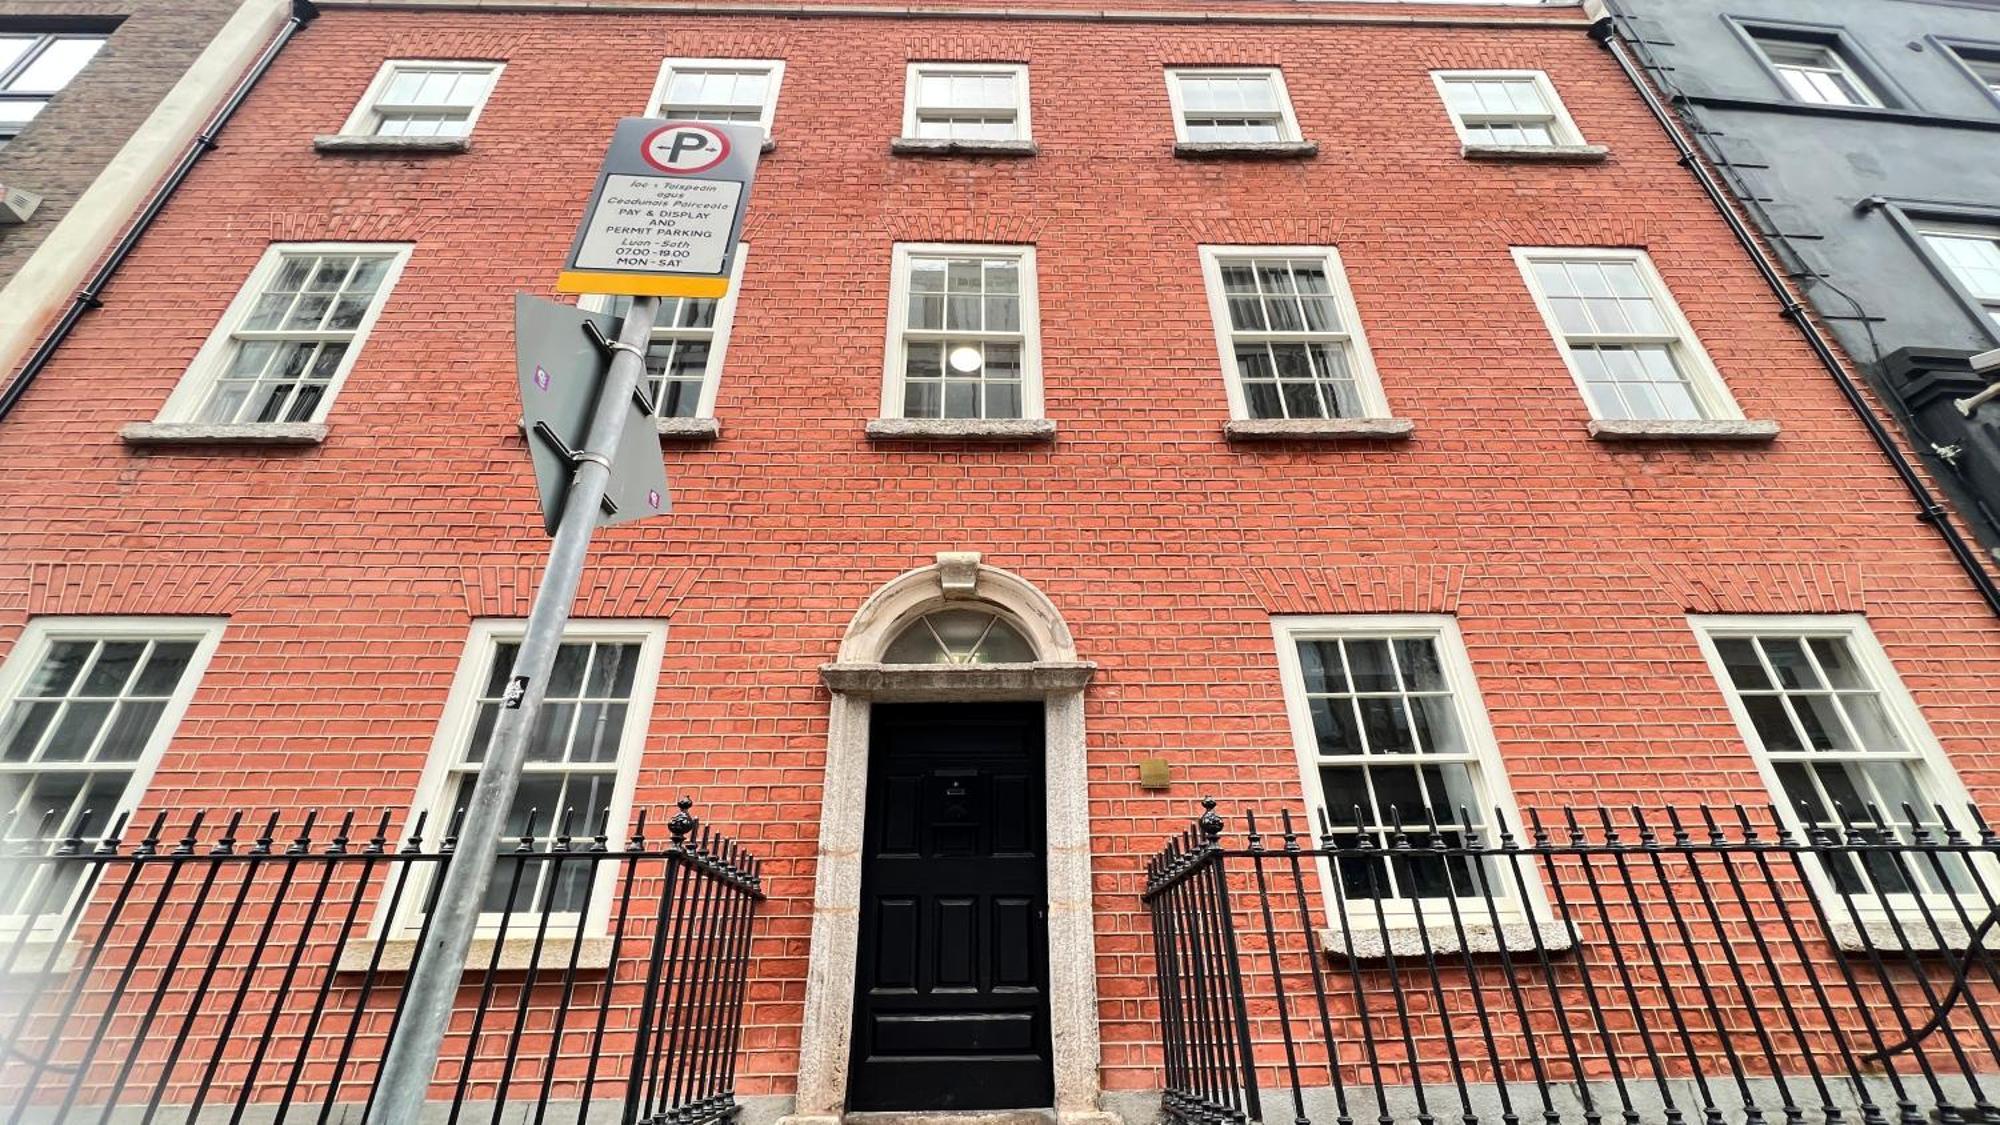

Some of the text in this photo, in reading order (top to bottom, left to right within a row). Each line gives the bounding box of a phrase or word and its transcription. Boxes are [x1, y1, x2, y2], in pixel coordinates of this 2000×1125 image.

[667, 131, 709, 163] P
[619, 208, 641, 216] PAY
[659, 210, 711, 219] DISPLAY
[649, 219, 676, 227] AND
[606, 226, 713, 238] PERMIT PARKING
[616, 257, 649, 266] MON
[657, 259, 683, 268] SAT
